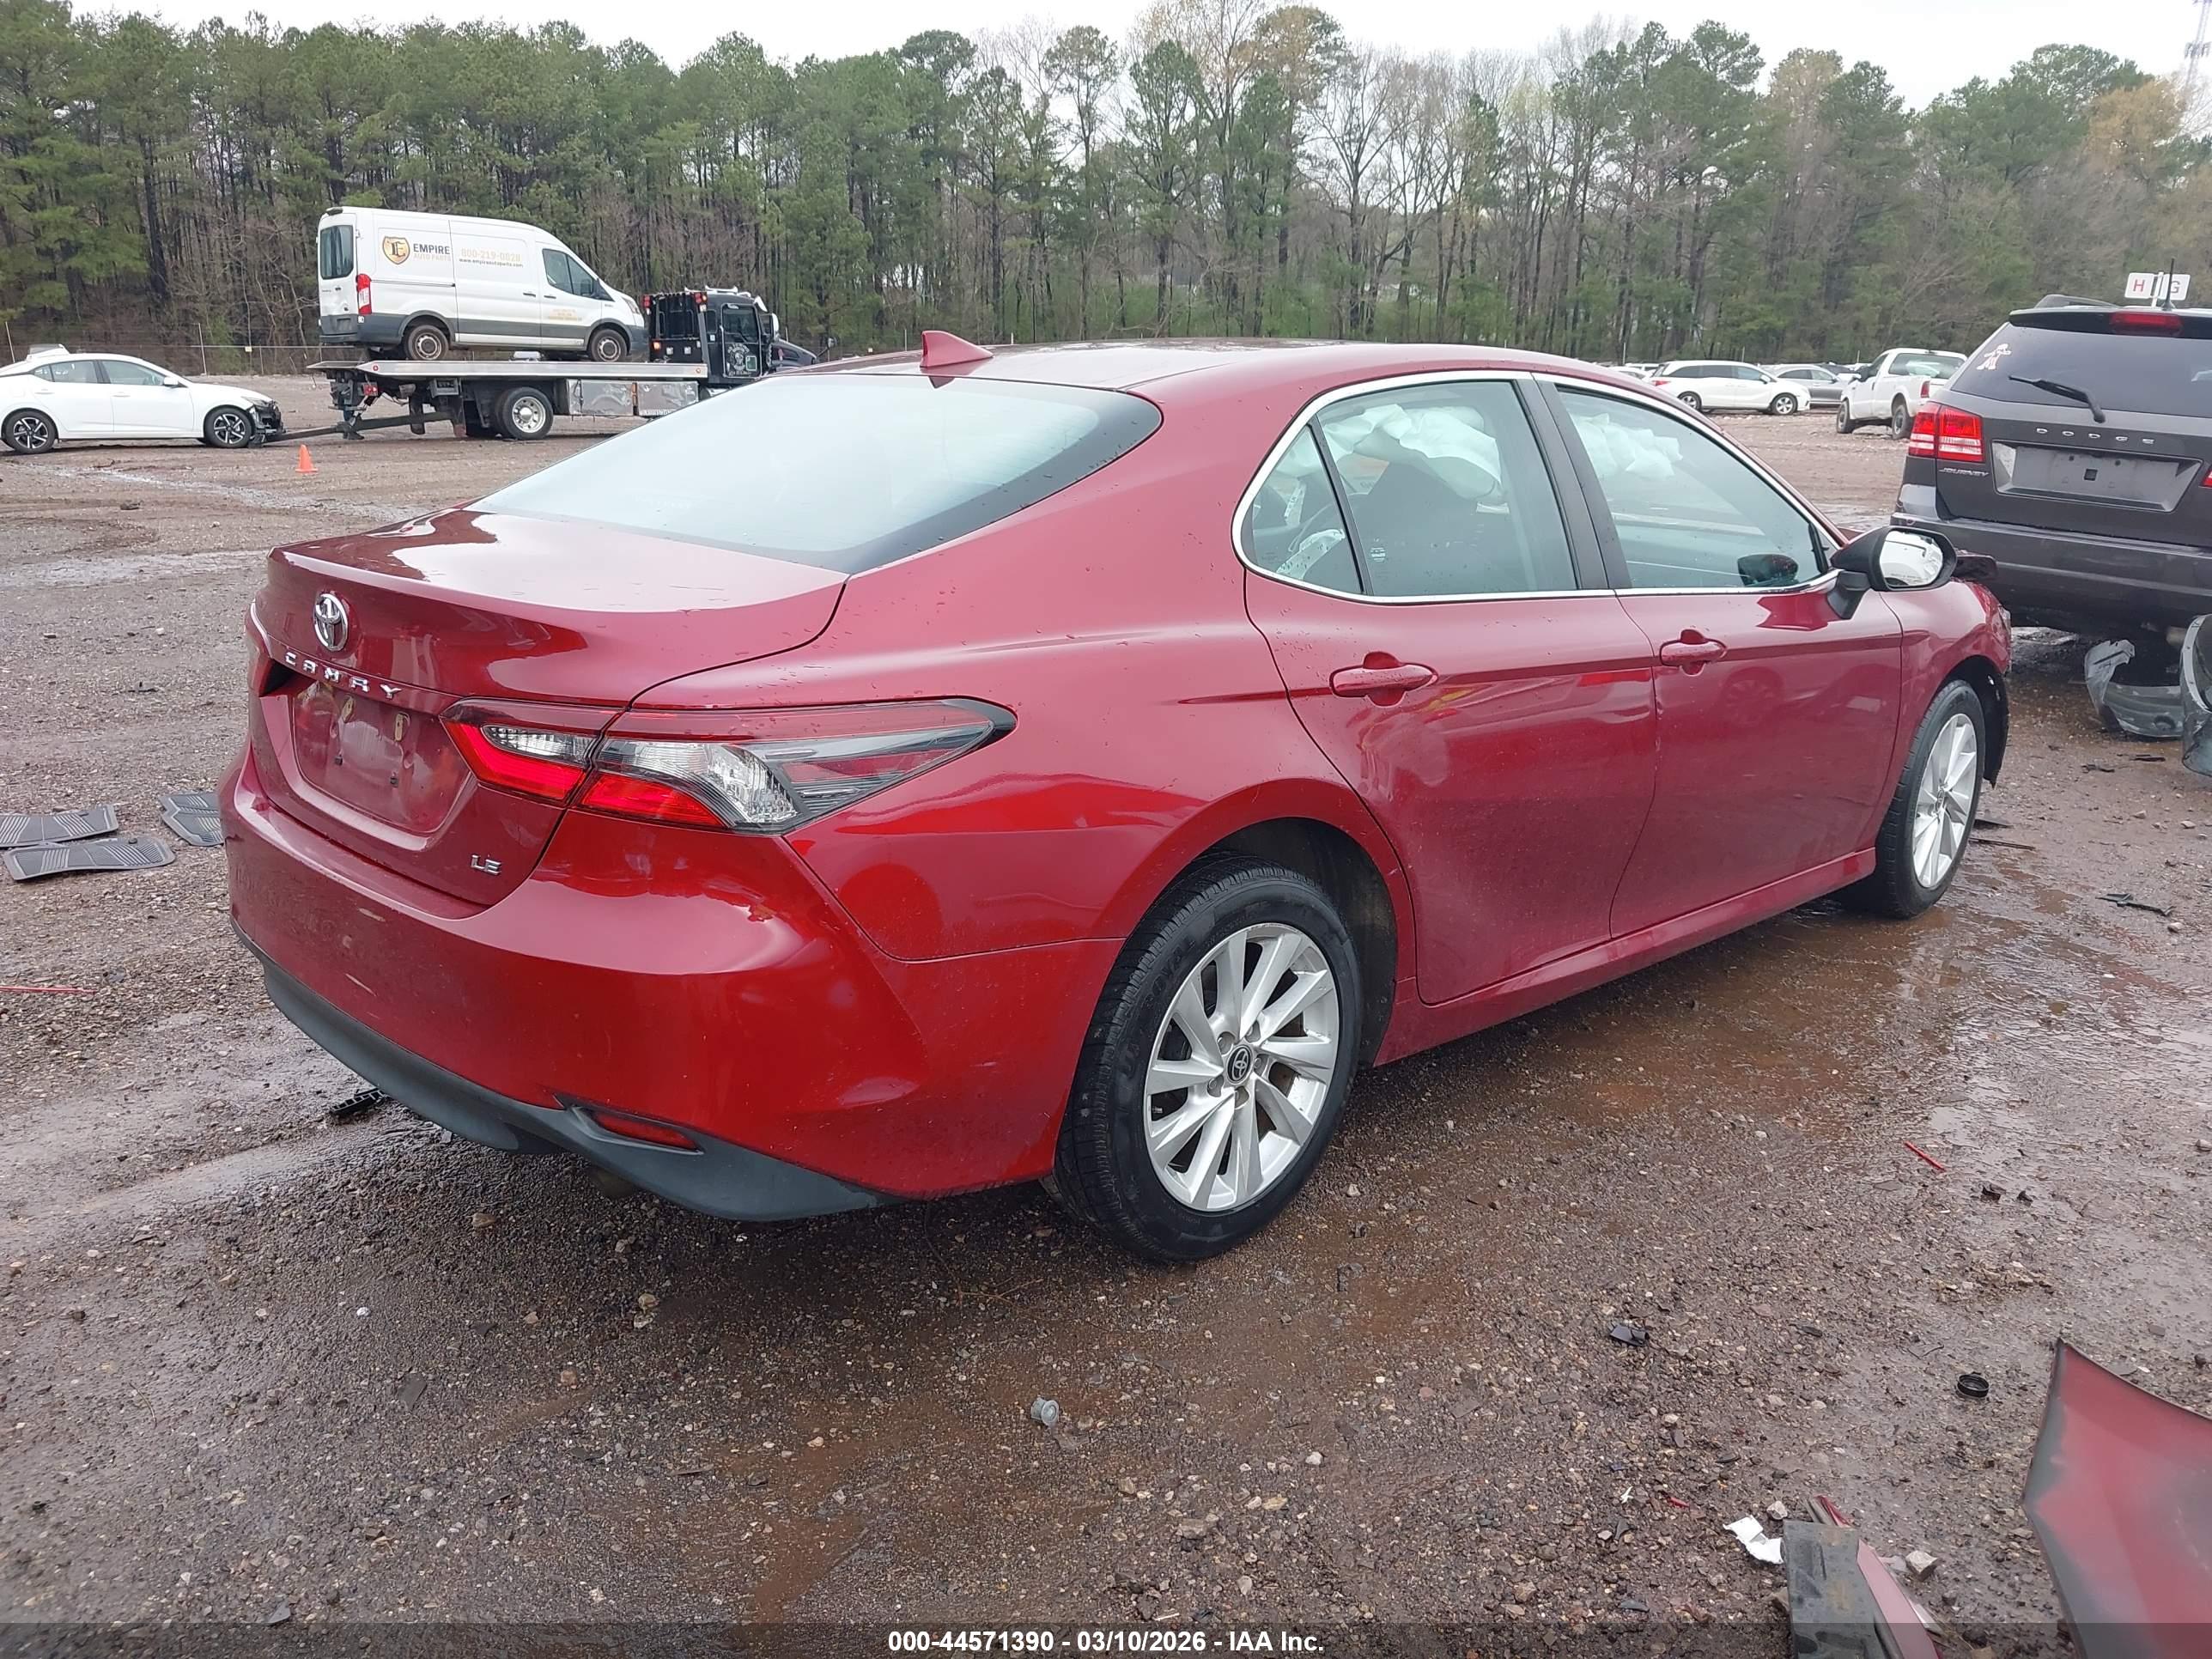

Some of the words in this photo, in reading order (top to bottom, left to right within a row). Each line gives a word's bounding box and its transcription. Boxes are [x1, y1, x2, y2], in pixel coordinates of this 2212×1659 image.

[413, 243, 451, 255] EMPIRE
[2133, 279, 2145, 292] H
[2170, 280, 2180, 294] G
[2036, 428, 2155, 445] DODGE
[1938, 467, 1990, 477] JOURNEY
[285, 652, 402, 699] CAMRY
[471, 854, 501, 875] LE
